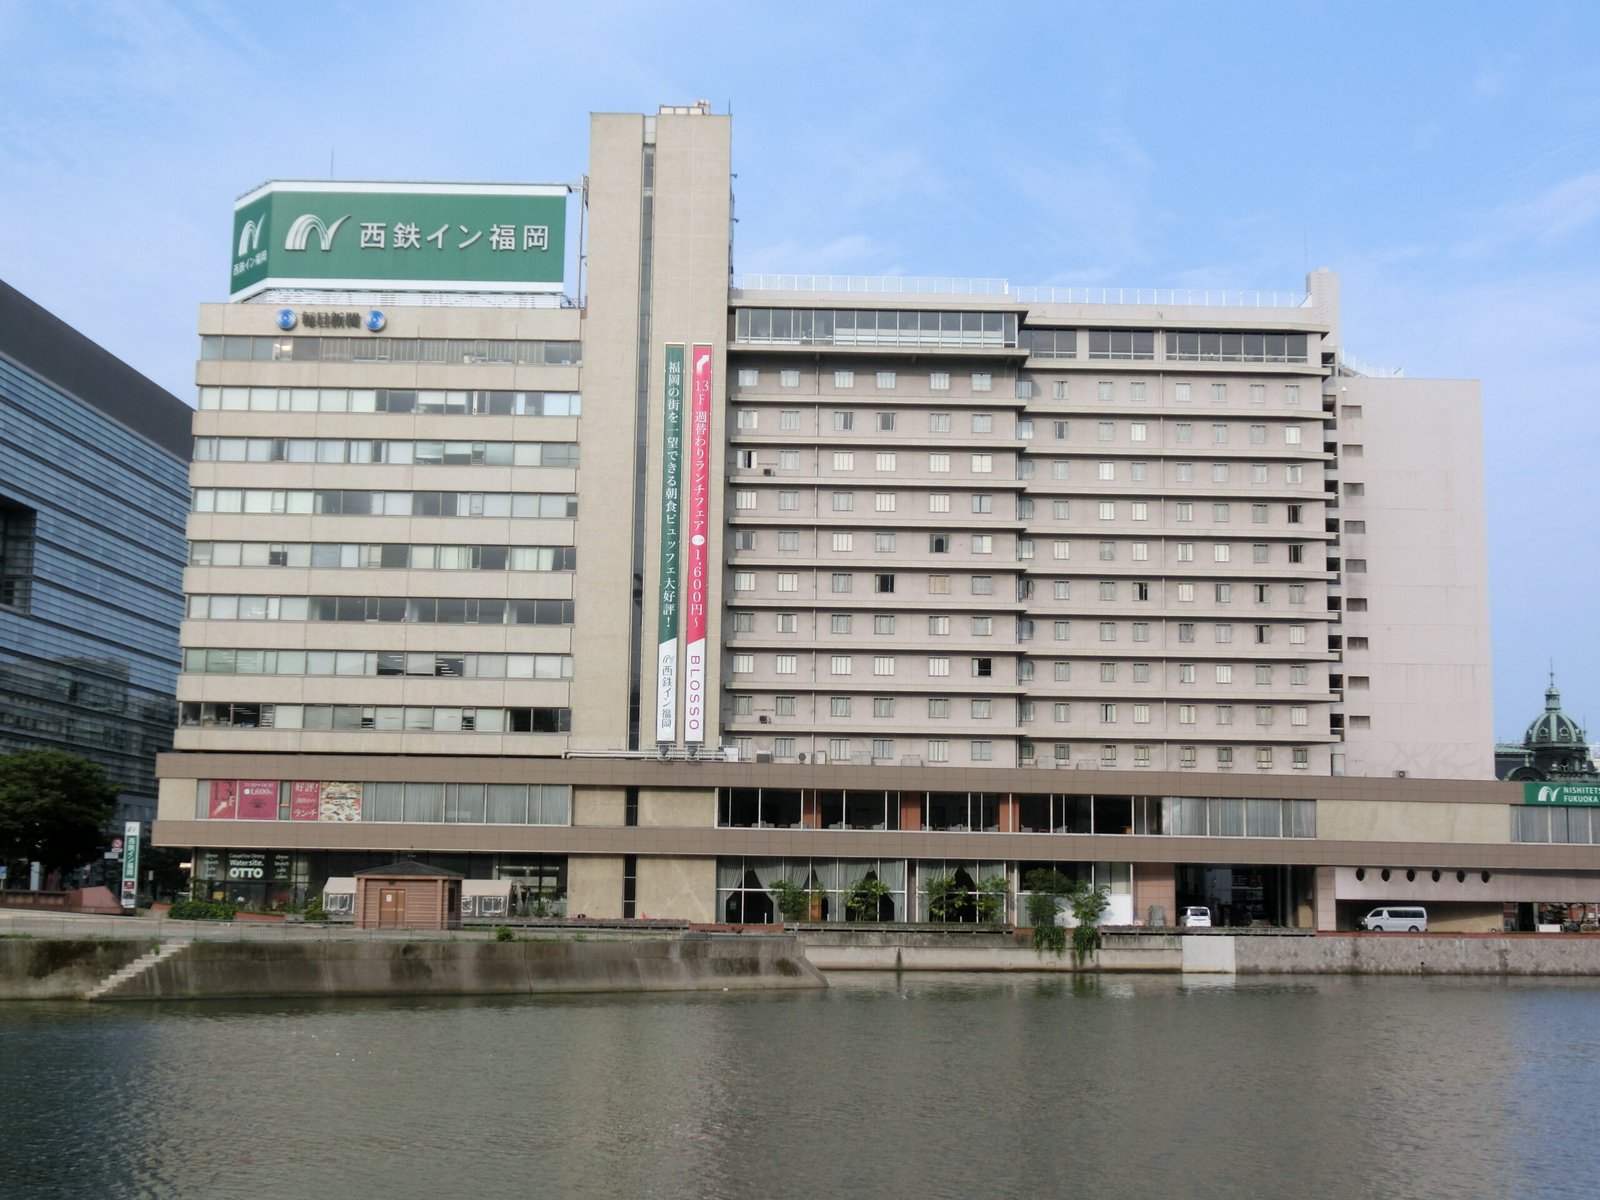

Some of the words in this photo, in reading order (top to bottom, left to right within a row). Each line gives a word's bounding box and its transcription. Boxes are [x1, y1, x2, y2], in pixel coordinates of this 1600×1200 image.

[359, 221, 549, 251] 西鉄イン福岡
[662, 665, 674, 728] 西鉄イン福岡
[689, 655, 701, 730] BLOSSO
[1563, 795, 1599, 803] FUKUOKA
[229, 867, 264, 879] OTTO
